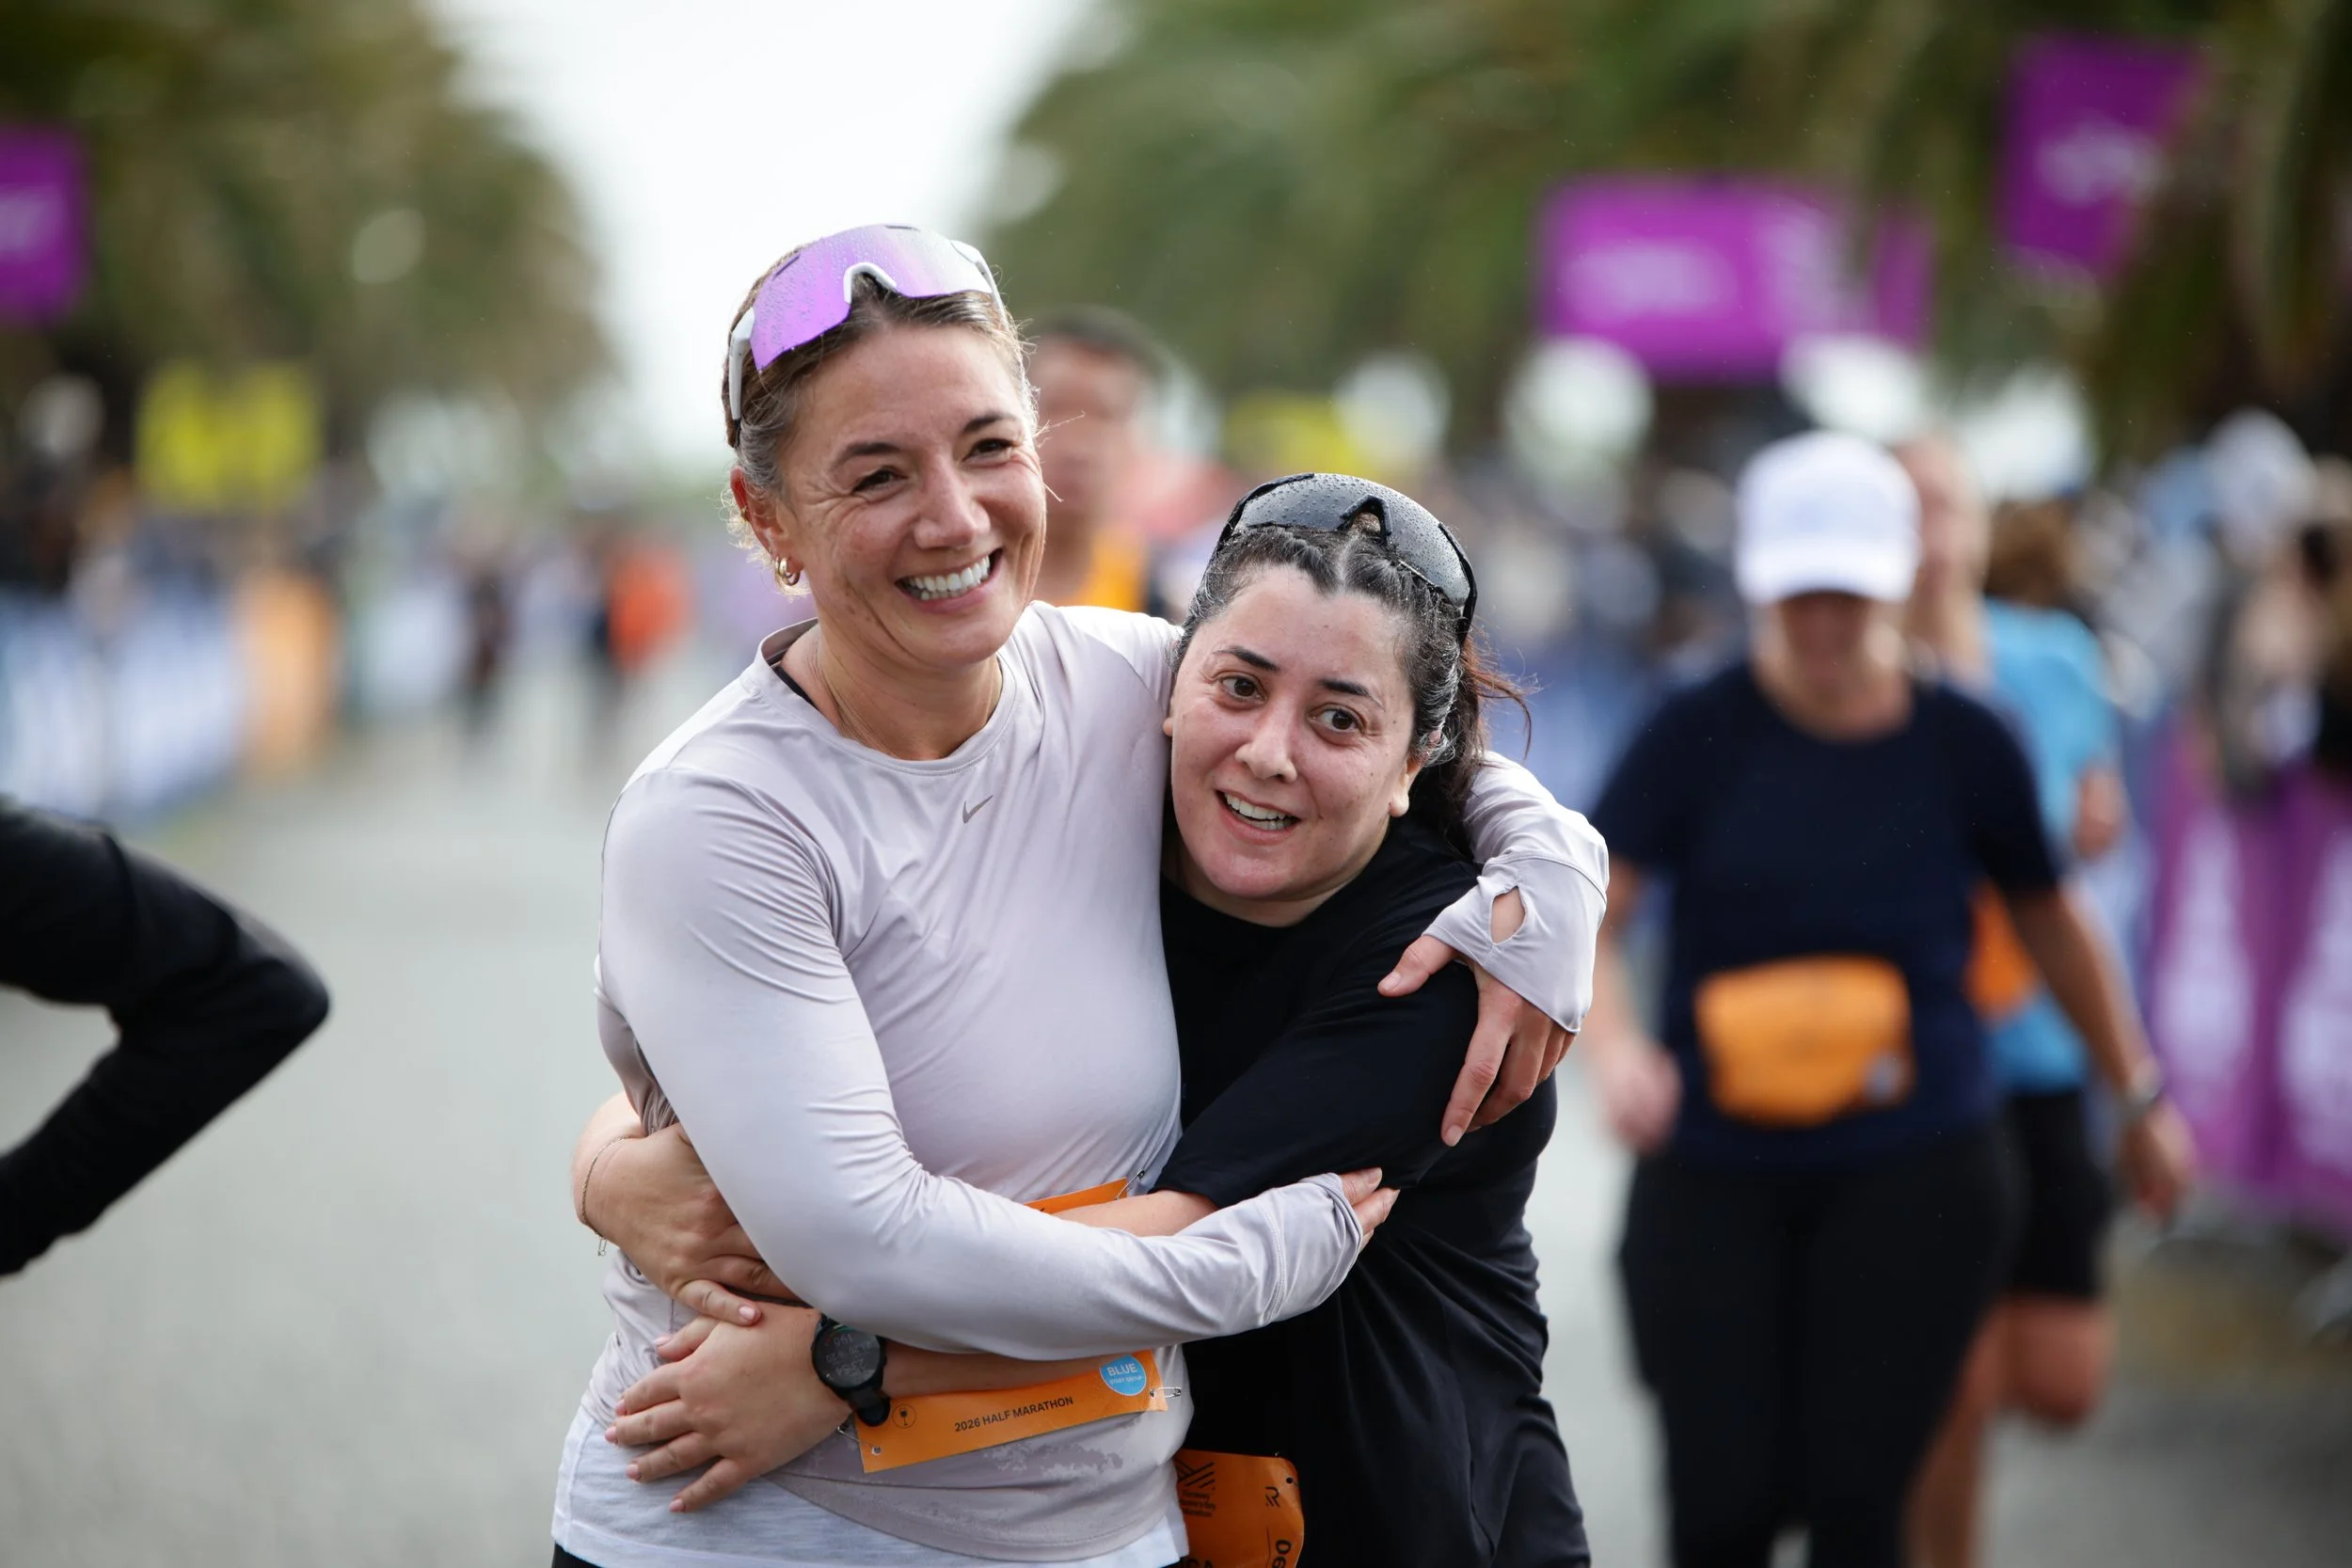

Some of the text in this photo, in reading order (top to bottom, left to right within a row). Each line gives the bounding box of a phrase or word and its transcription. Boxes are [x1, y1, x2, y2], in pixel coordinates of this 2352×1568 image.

[1106, 1363, 1137, 1376] BLUE
[954, 1396, 1074, 1433] 2026 HALF MARATHON
